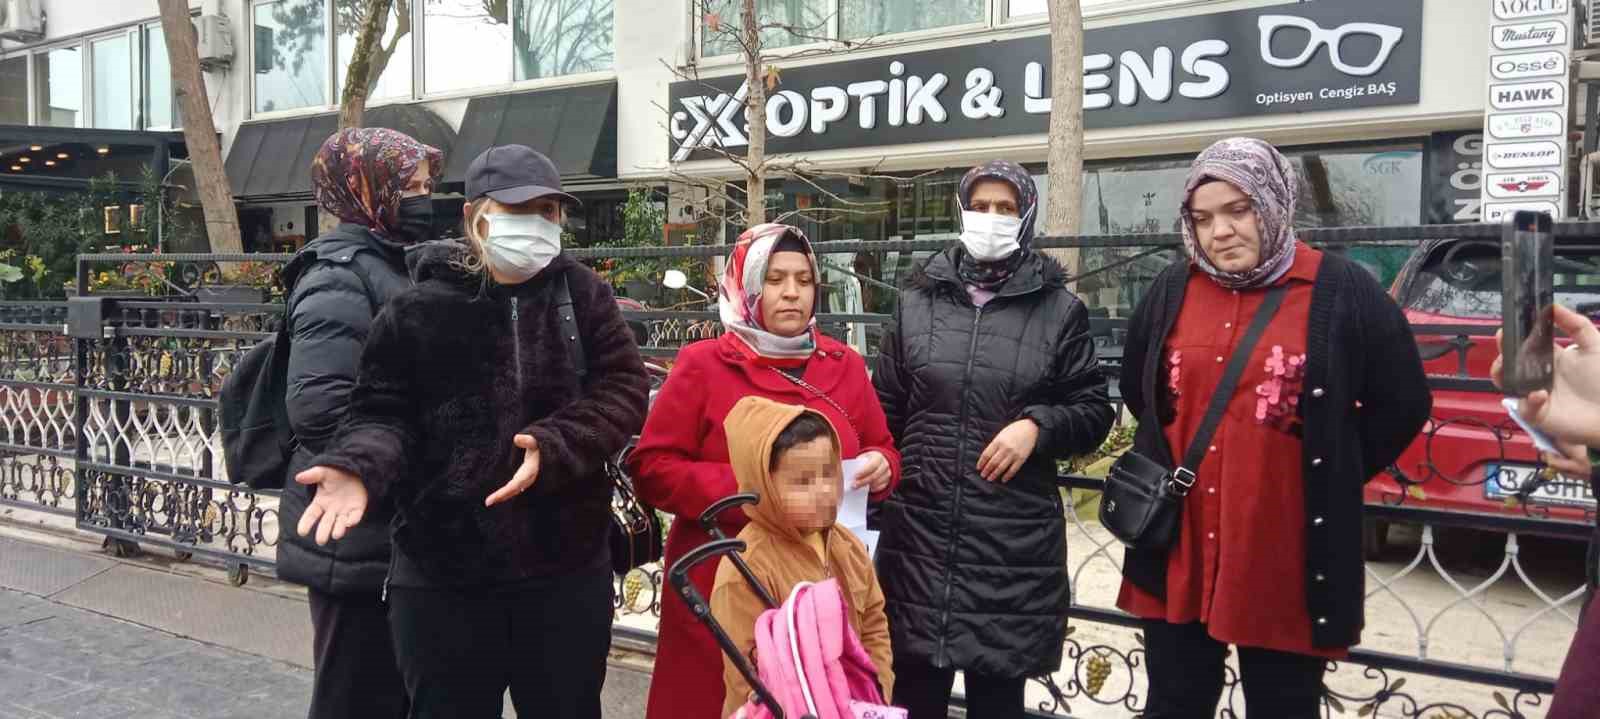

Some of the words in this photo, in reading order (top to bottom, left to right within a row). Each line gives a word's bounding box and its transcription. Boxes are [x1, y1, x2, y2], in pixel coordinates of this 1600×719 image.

[1501, 26, 1557, 43] Mustang
[765, 61, 949, 138] OPTİK
[961, 67, 1006, 119] &
[1024, 39, 1231, 114] LENS
[1256, 91, 1313, 106] Optisyen
[1320, 84, 1365, 99] Cengiz
[1367, 82, 1397, 96] BAŞ
[1498, 87, 1555, 104] HAWK
[1502, 150, 1555, 160] DUNLOP
